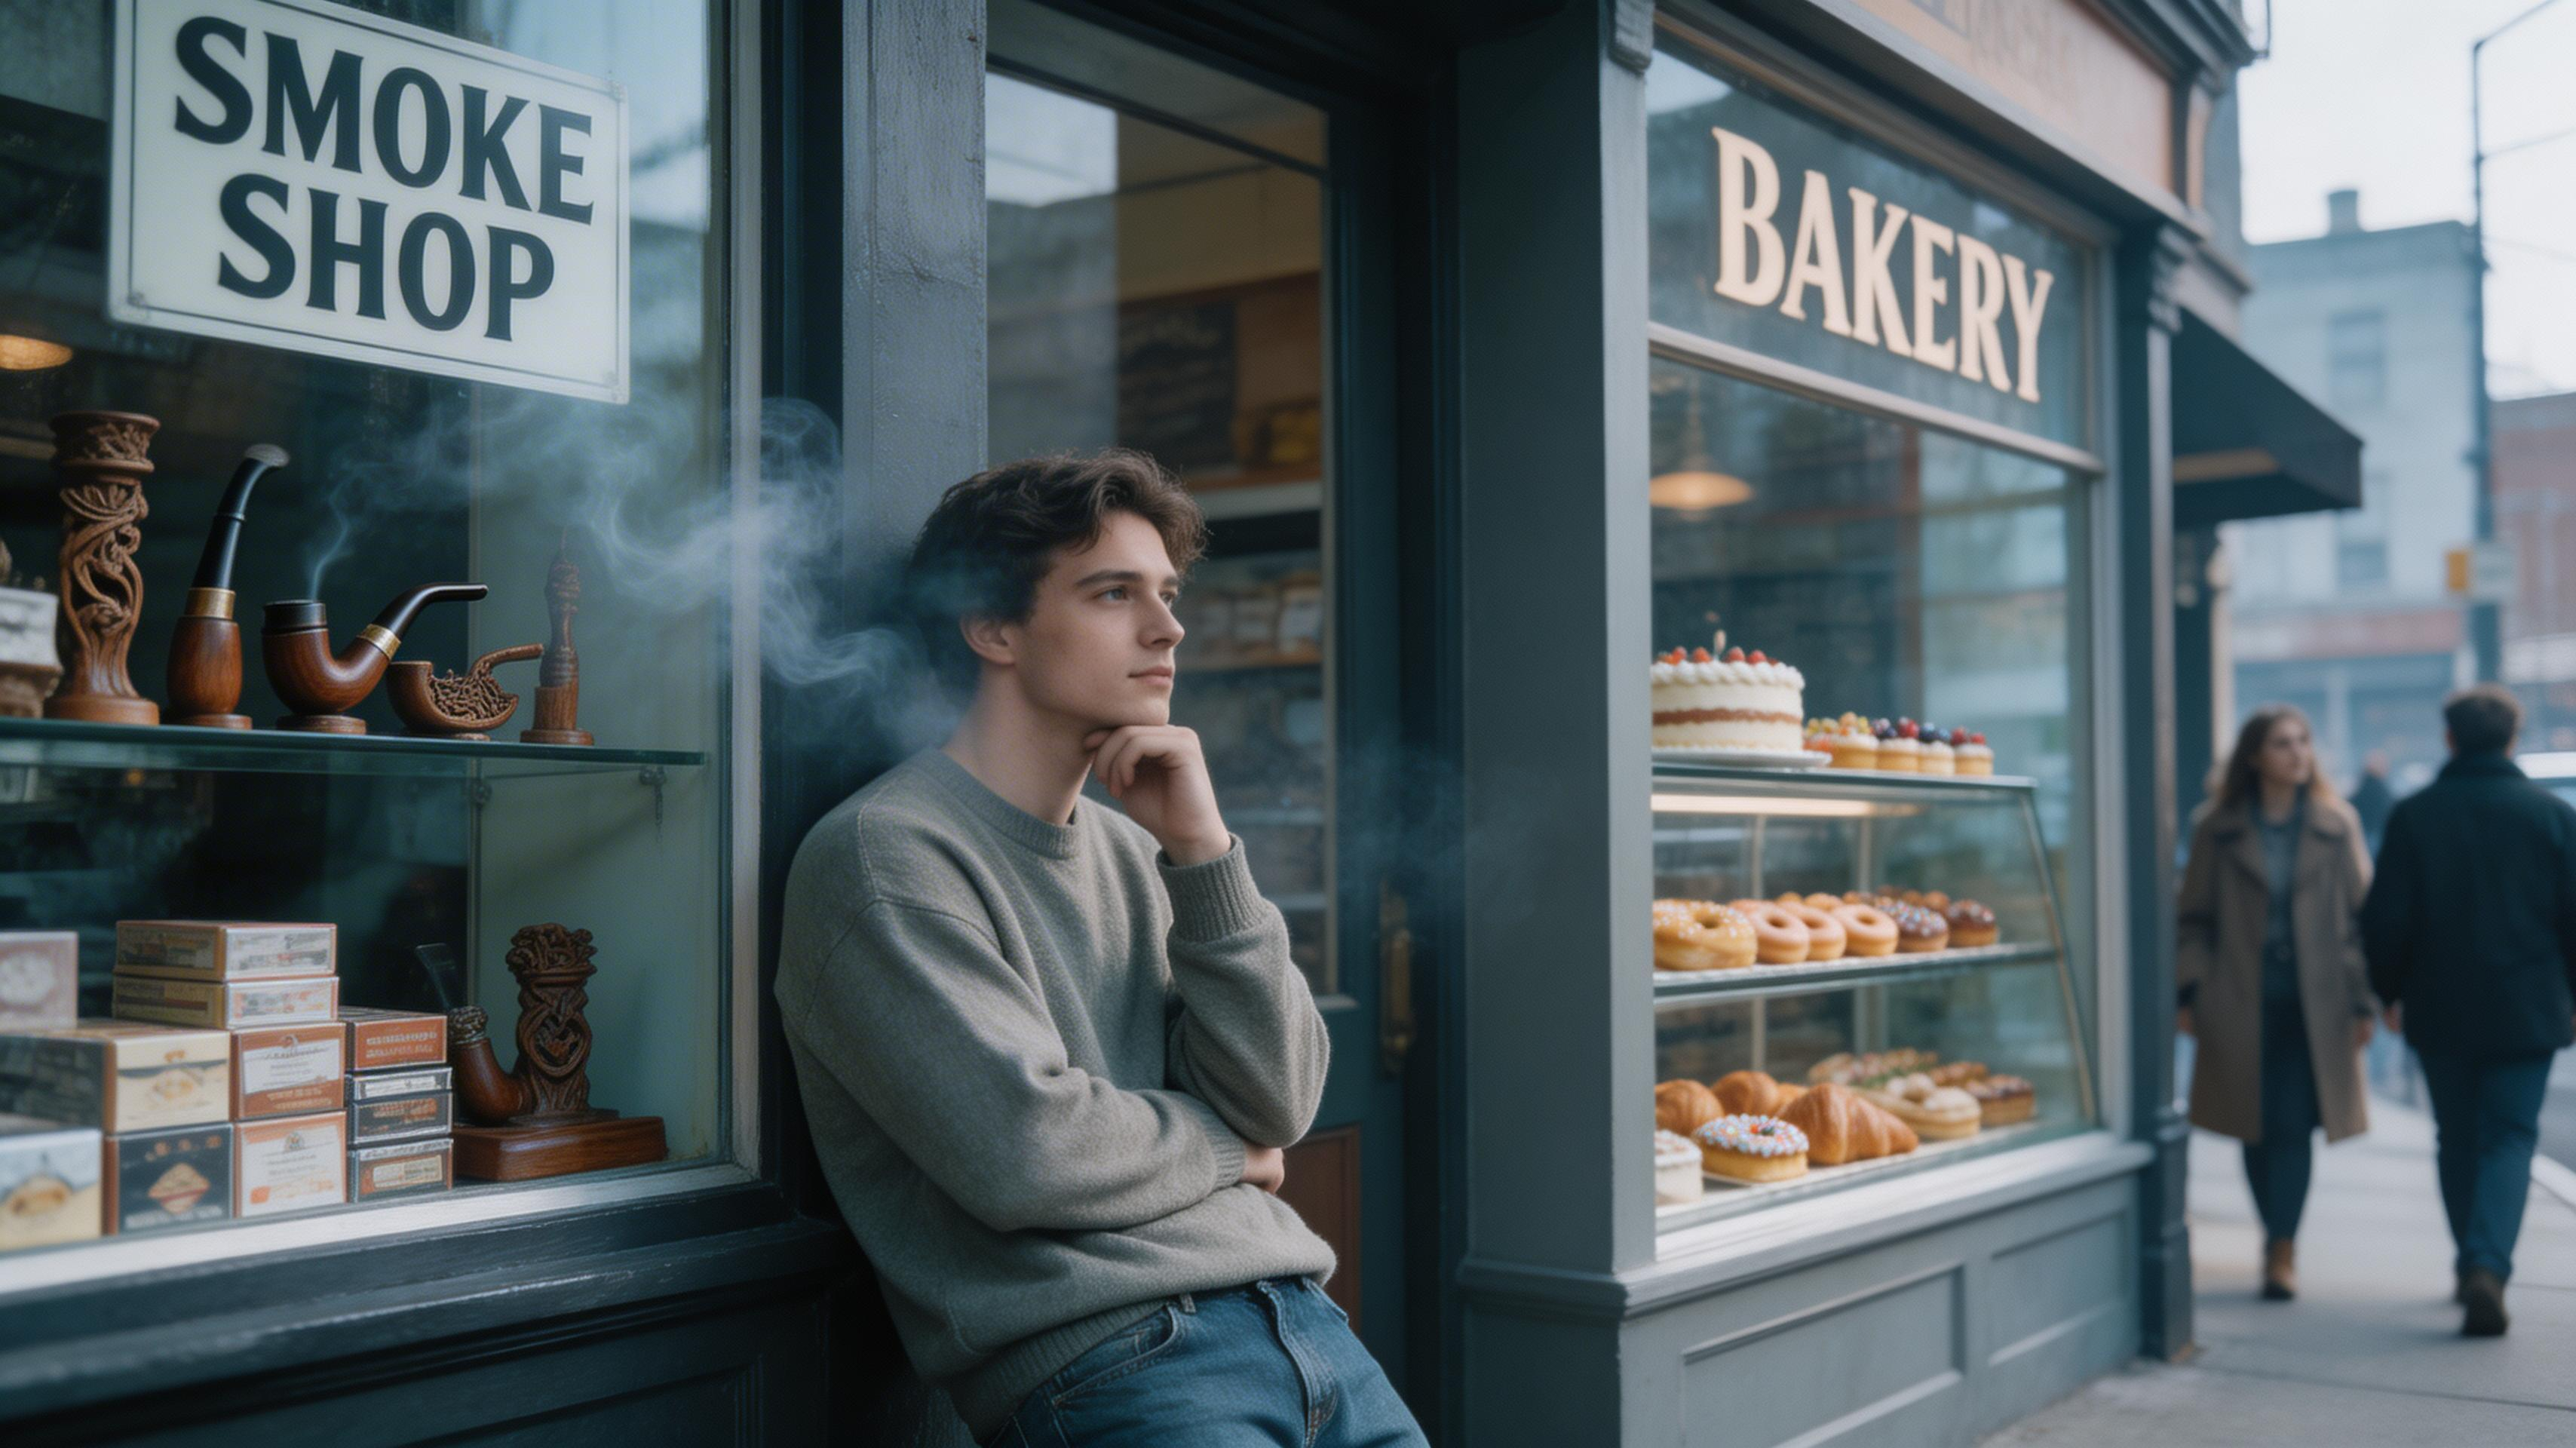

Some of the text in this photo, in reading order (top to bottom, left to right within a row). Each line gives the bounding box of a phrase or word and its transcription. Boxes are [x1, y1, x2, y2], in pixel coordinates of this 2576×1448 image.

[174, 17, 594, 225] SMOKE
[218, 173, 554, 342] SHOP
[1712, 127, 2054, 402] BAKERY
